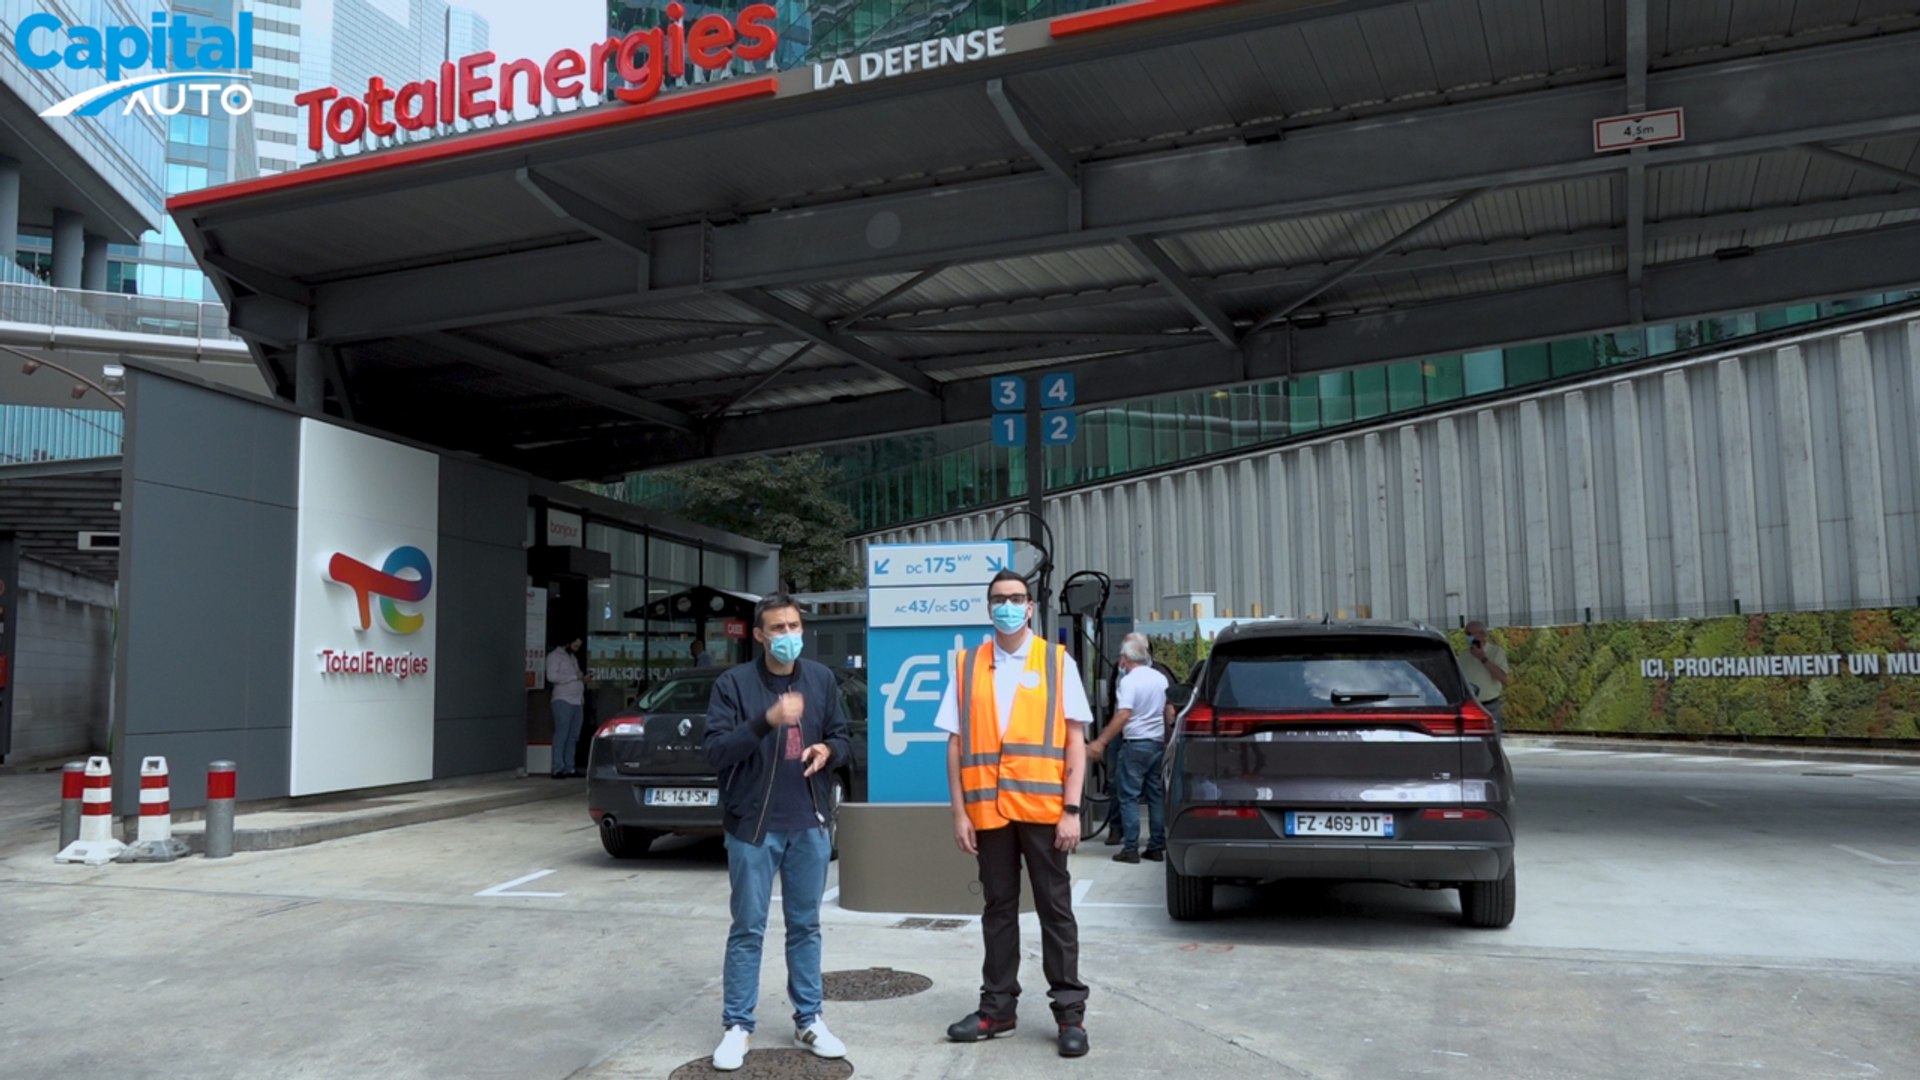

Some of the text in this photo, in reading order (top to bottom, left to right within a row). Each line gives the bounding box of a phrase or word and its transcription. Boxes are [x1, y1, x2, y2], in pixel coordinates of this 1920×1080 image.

[813, 26, 1006, 91] LA DEFENSE
[295, 1, 778, 152] TotalEnergies
[1000, 381, 1016, 405] 3
[1048, 378, 1068, 402] 4
[1003, 418, 1014, 442] 1
[1050, 416, 1068, 439] 2
[906, 564, 922, 574] DC
[924, 556, 956, 573] 175
[322, 649, 429, 679] TotalEnergies
[1640, 658, 1669, 679] ICI,
[1674, 654, 1842, 677] PROCHAINEMENT
[1848, 654, 1879, 675] UN
[1297, 815, 1380, 831] FZ-469-DT
